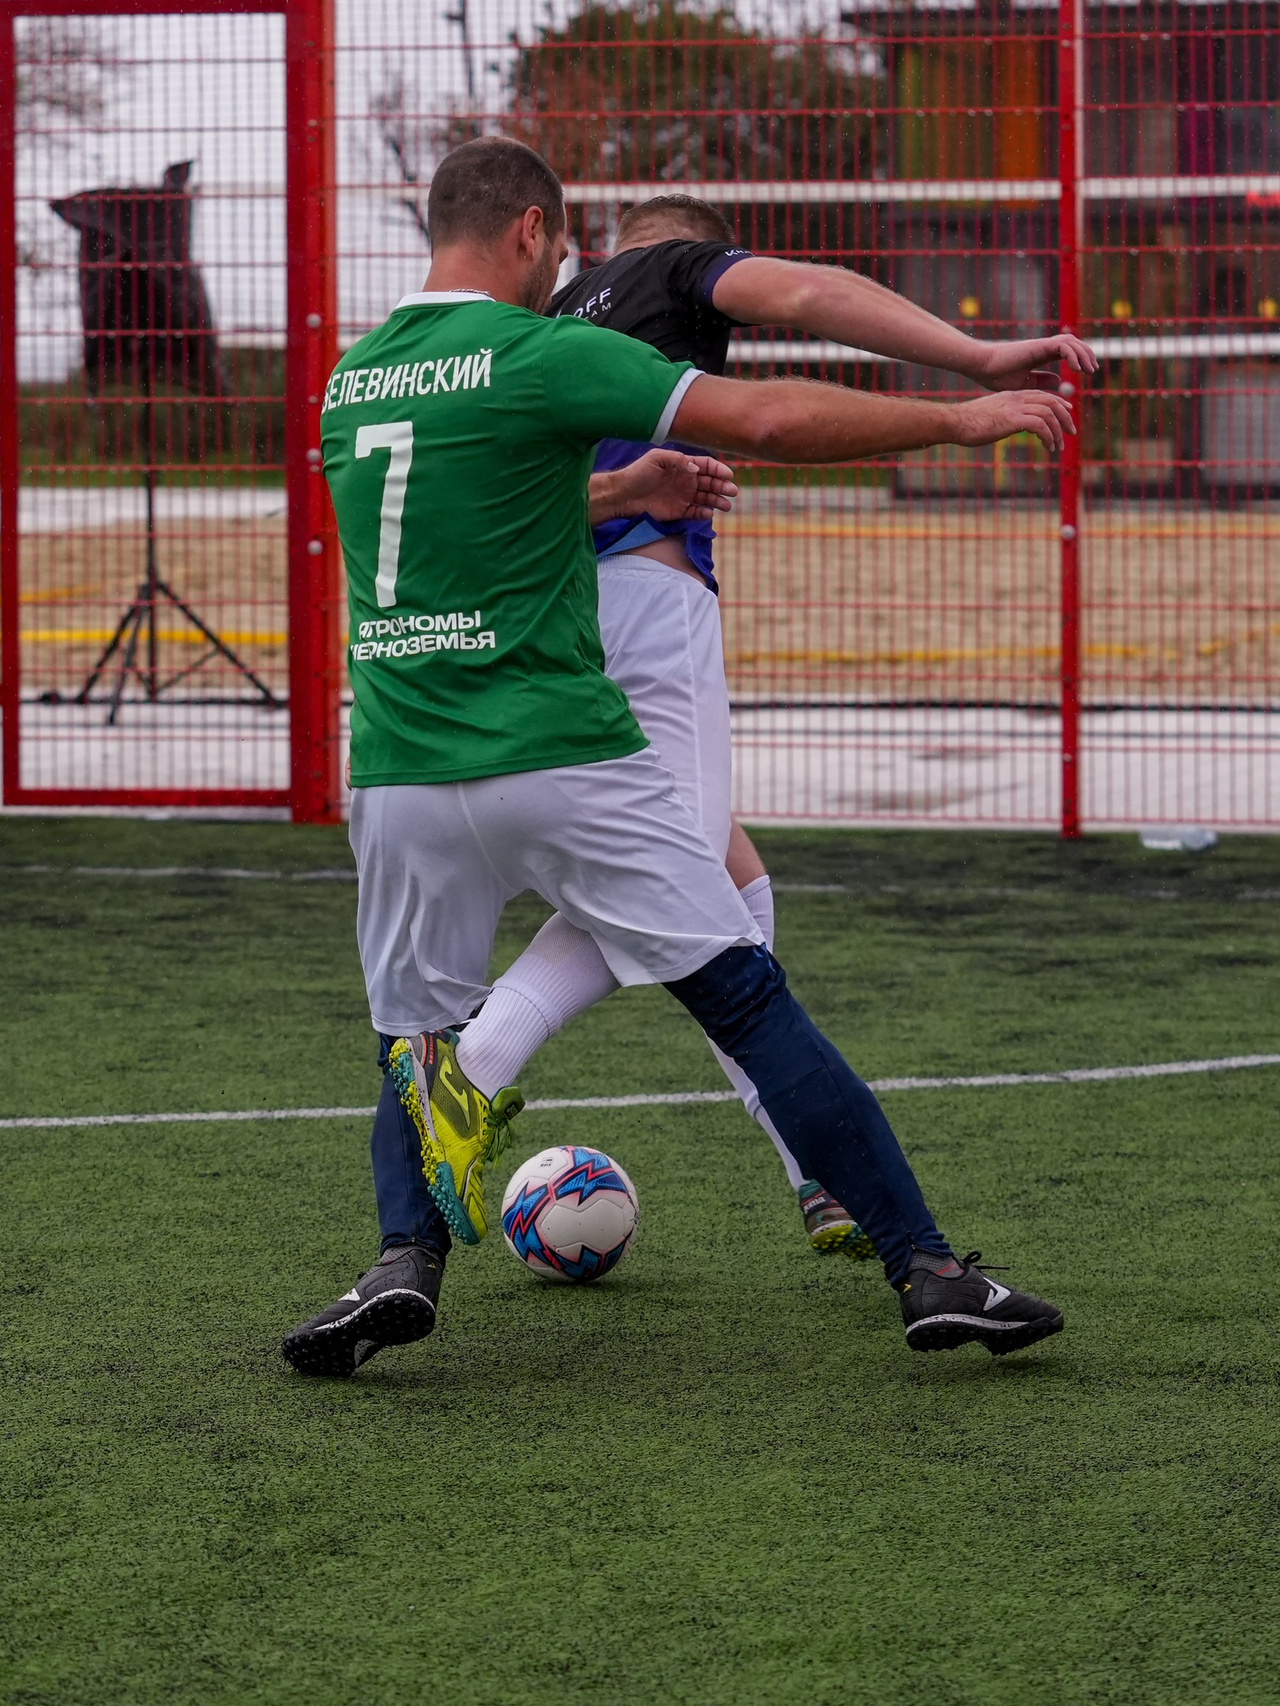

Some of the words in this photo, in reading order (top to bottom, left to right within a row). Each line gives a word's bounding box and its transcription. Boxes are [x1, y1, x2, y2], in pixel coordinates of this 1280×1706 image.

[355, 420, 414, 608] 7
[358, 610, 481, 640] АГРОНОМЫ
[350, 631, 496, 661] ЧЕРНОЗЕМЬЯ
